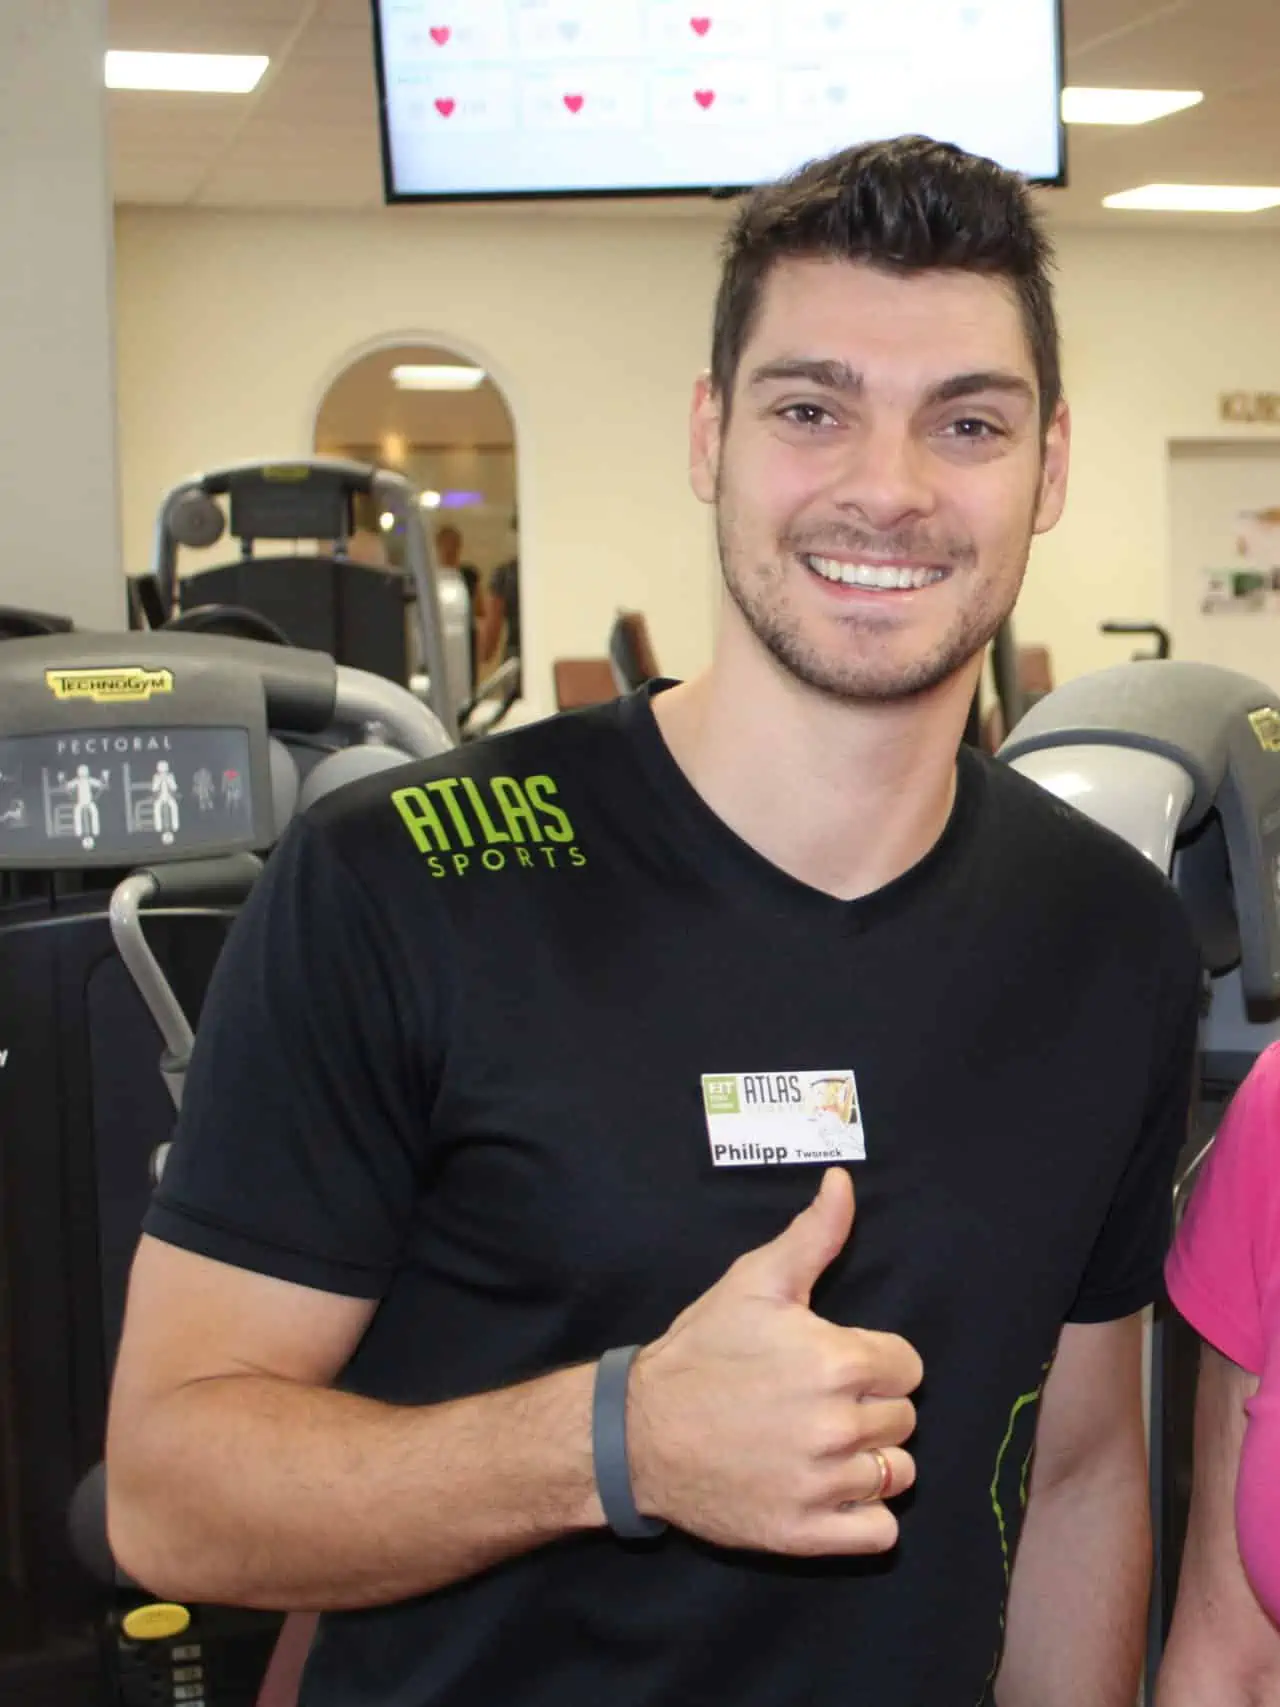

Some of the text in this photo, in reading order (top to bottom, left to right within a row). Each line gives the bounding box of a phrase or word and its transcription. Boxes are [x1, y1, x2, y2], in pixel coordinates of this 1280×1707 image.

[57, 736, 171, 754] PECTORAL
[391, 774, 575, 854] ATLAS
[427, 846, 587, 878] SPORTS
[744, 1076, 802, 1104] ATLAS
[715, 1144, 788, 1164] Philipp
